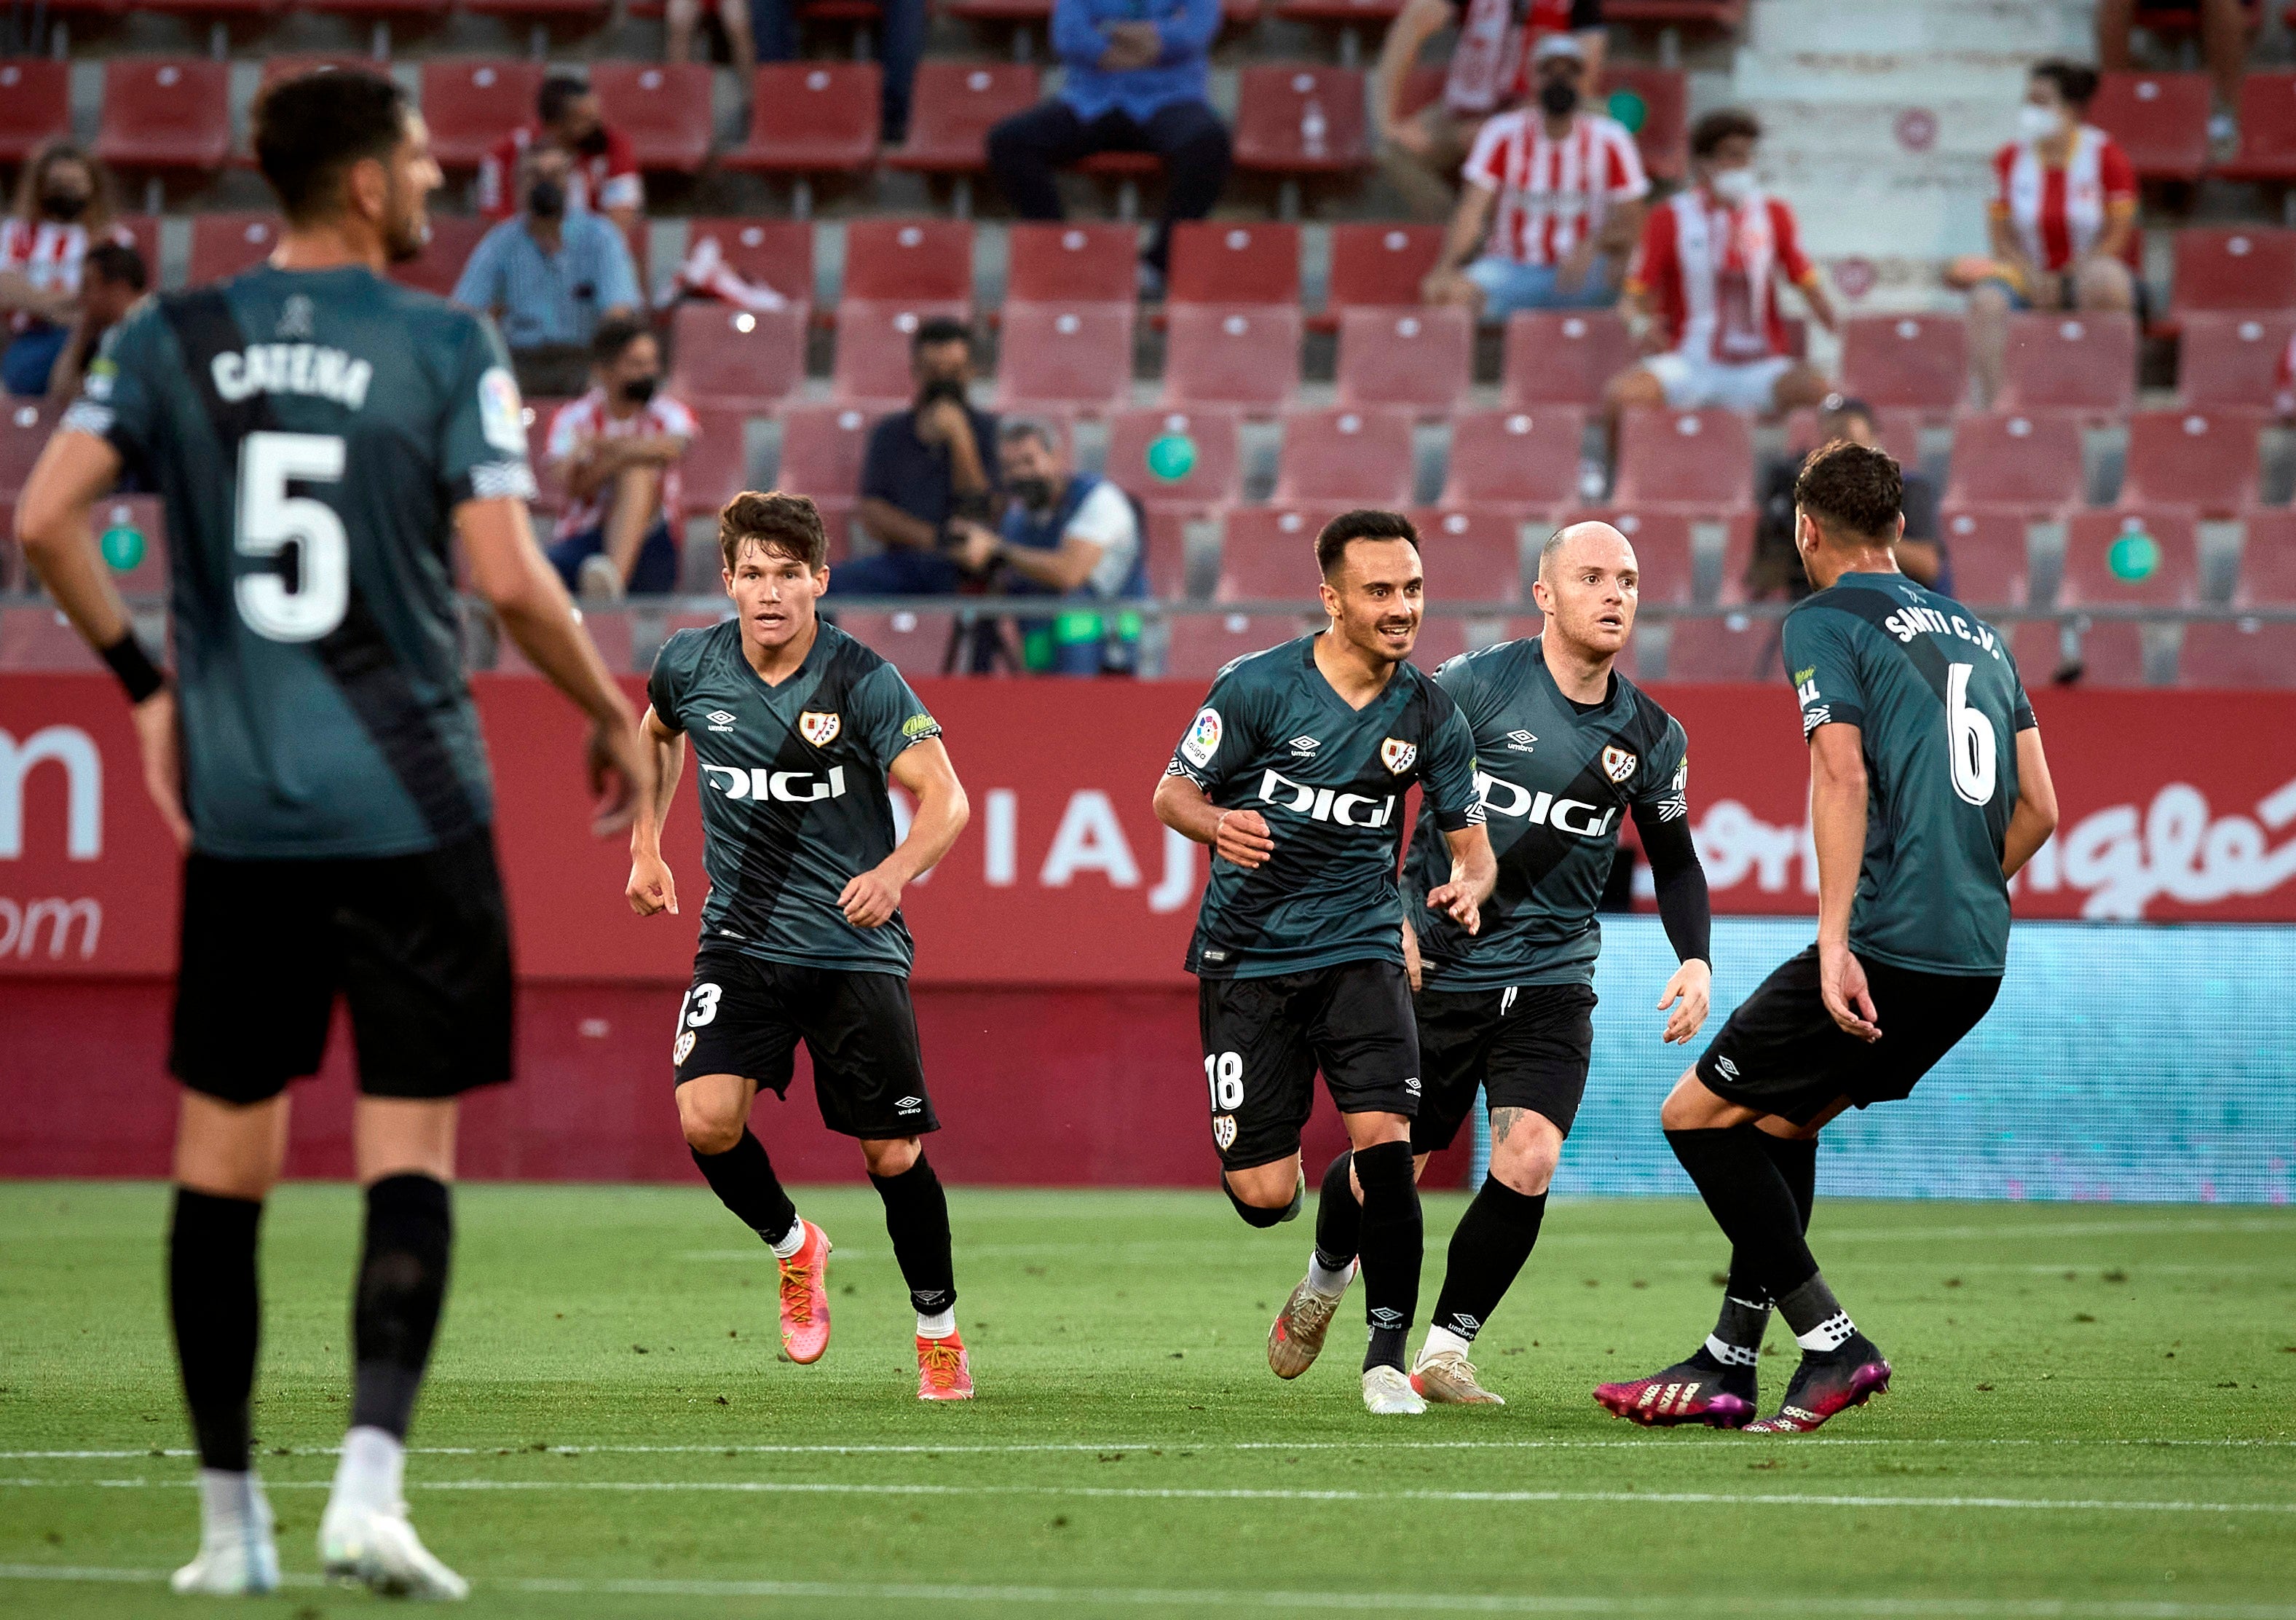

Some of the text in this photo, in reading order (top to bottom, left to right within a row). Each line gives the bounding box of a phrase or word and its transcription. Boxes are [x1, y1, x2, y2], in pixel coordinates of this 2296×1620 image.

[211, 343, 372, 412] CATENA
[234, 430, 350, 642] 5
[1885, 606, 1950, 642] SANTI
[1187, 739, 1207, 760] LaLiga
[1507, 743, 1534, 752] umbro
[1946, 663, 1997, 806] 6
[701, 764, 847, 802] DIGI
[1258, 768, 1396, 828] DIGI
[1478, 770, 1617, 837] DIGI
[1204, 1051, 1244, 1112] 18
[1448, 1323, 1475, 1339] umbro
